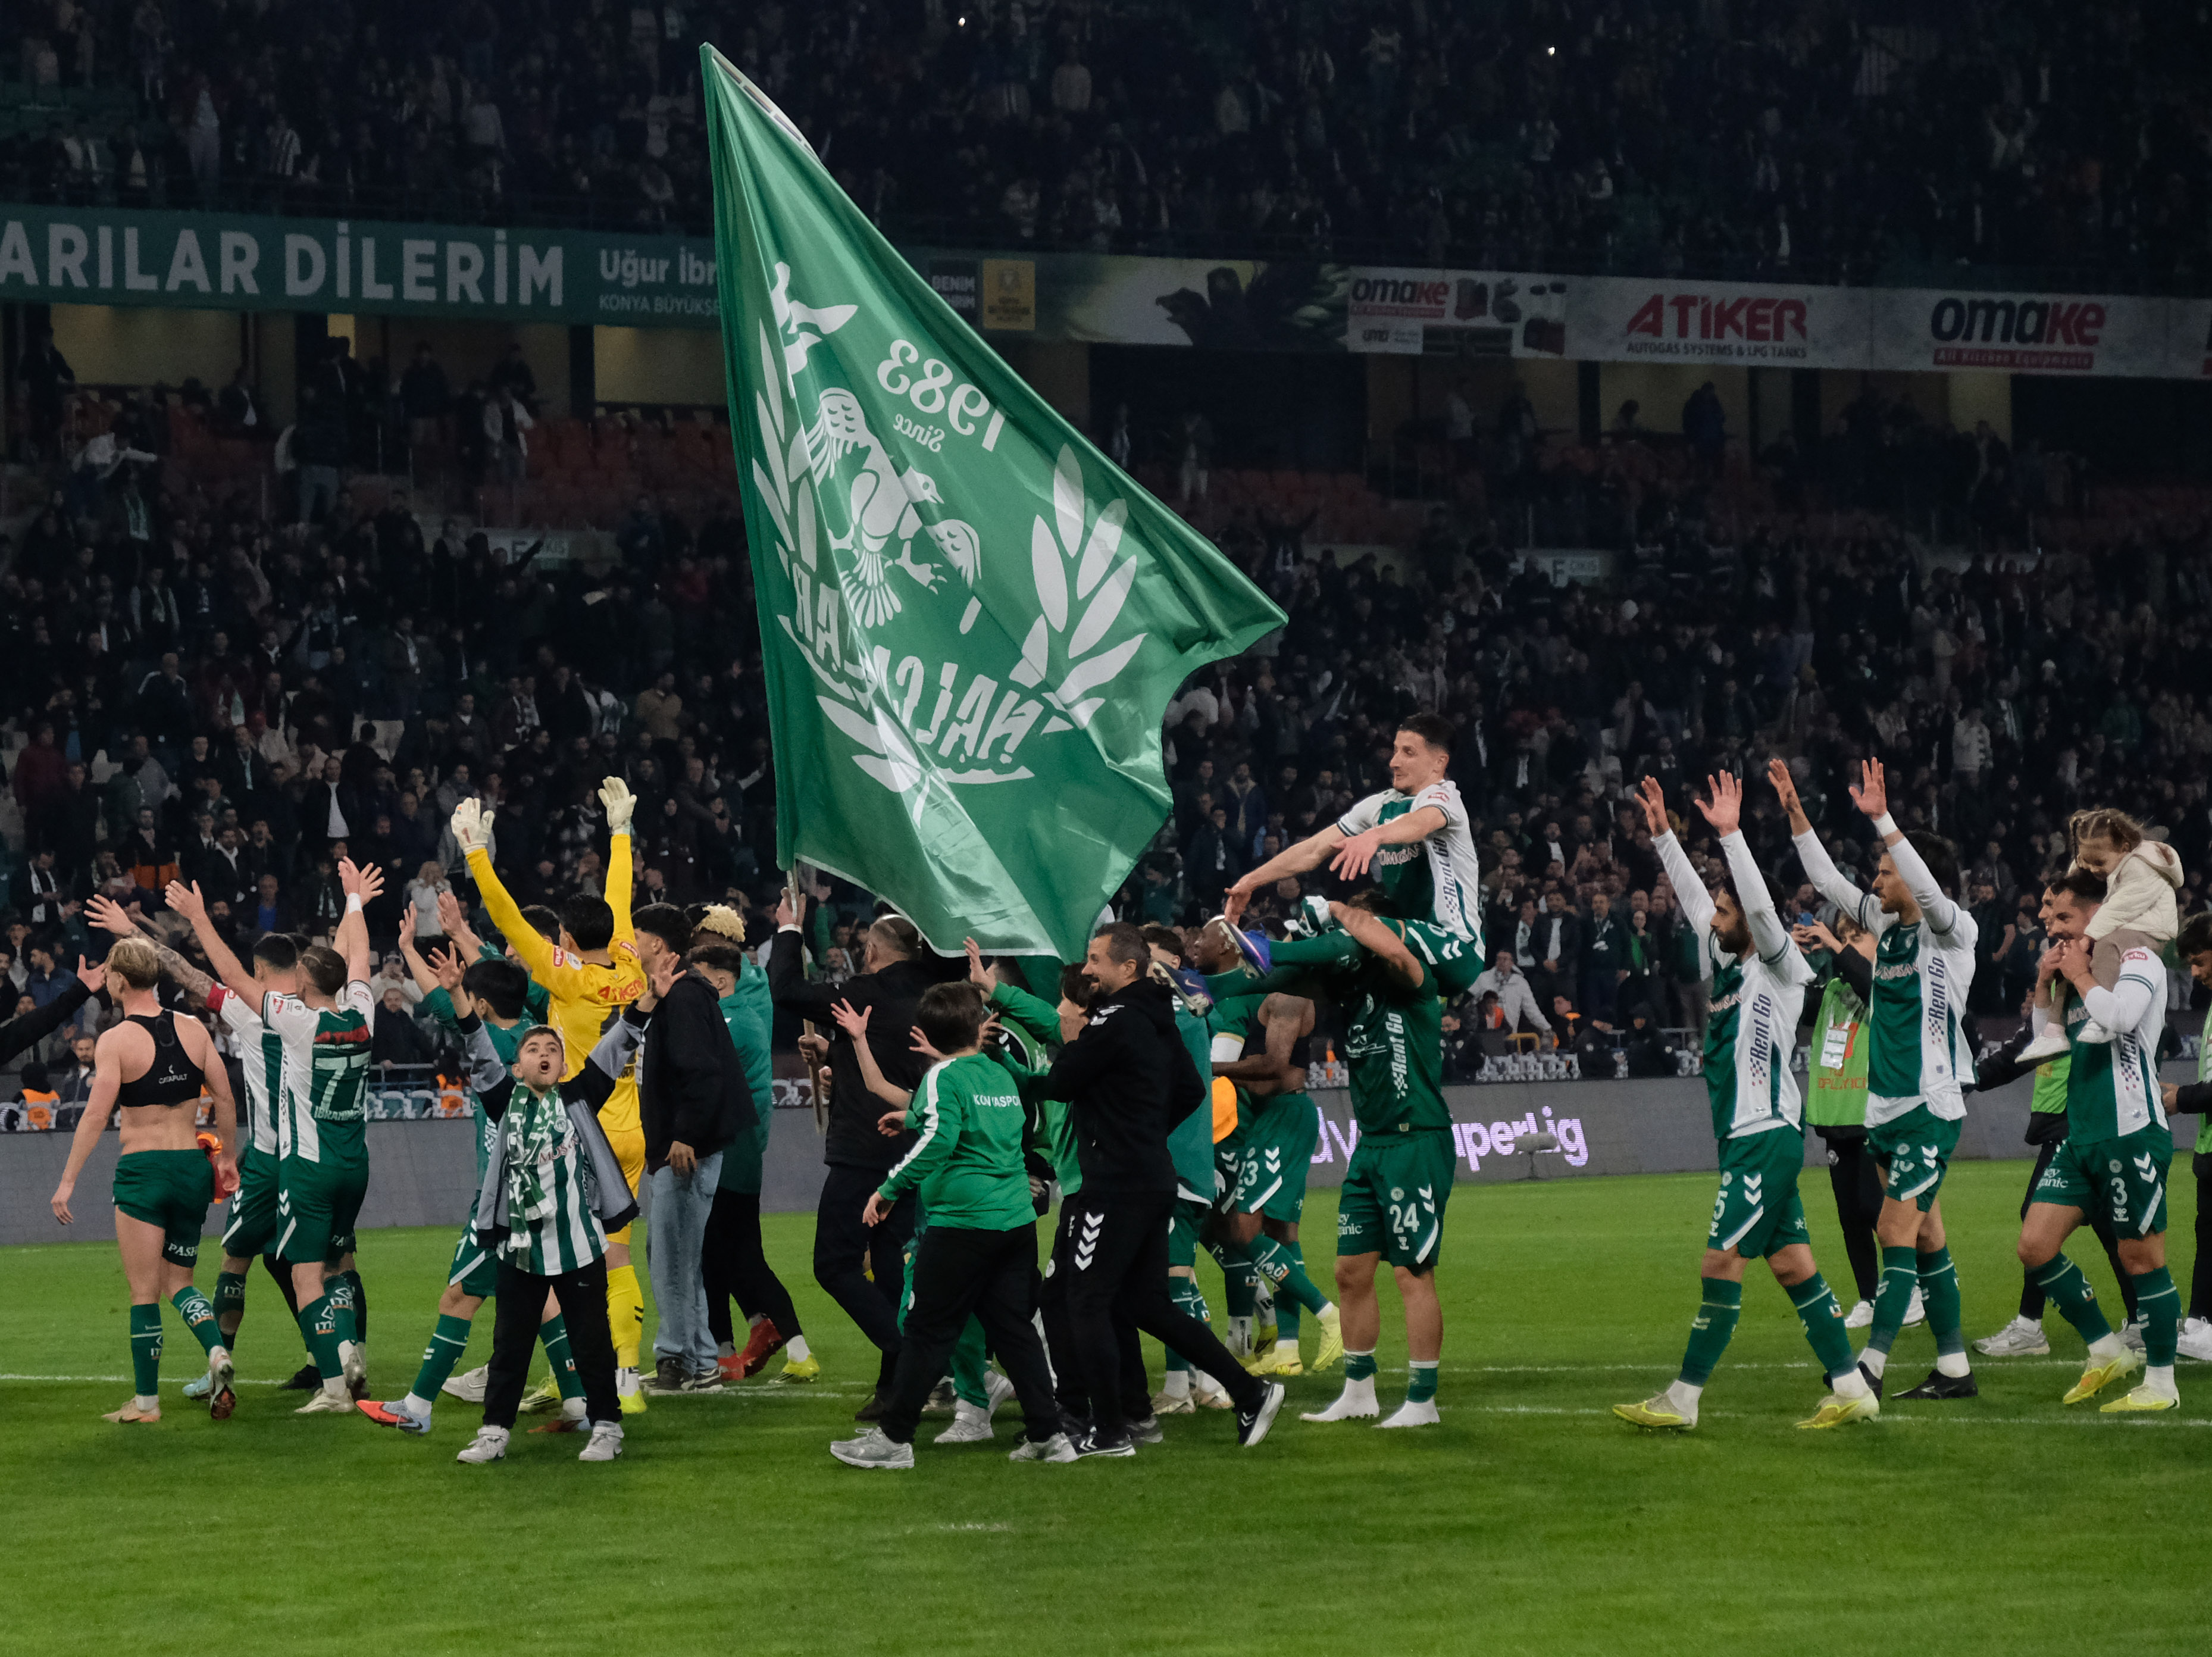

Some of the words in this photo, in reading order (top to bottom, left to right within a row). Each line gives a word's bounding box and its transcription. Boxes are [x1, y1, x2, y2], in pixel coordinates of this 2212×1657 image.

[284, 221, 563, 306] DİLERİM
[600, 249, 670, 287] Uğur
[599, 295, 650, 311] KONYA
[1928, 956, 1945, 979] Go
[1753, 993, 1772, 1018] Go
[1928, 981, 1946, 1020] Rent
[1385, 1012, 1404, 1035] Go
[1389, 1035, 1407, 1076] Rent
[1750, 1018, 1770, 1062] Rent
[2111, 1177, 2128, 1205] 3
[1389, 1202, 1420, 1234] 24
